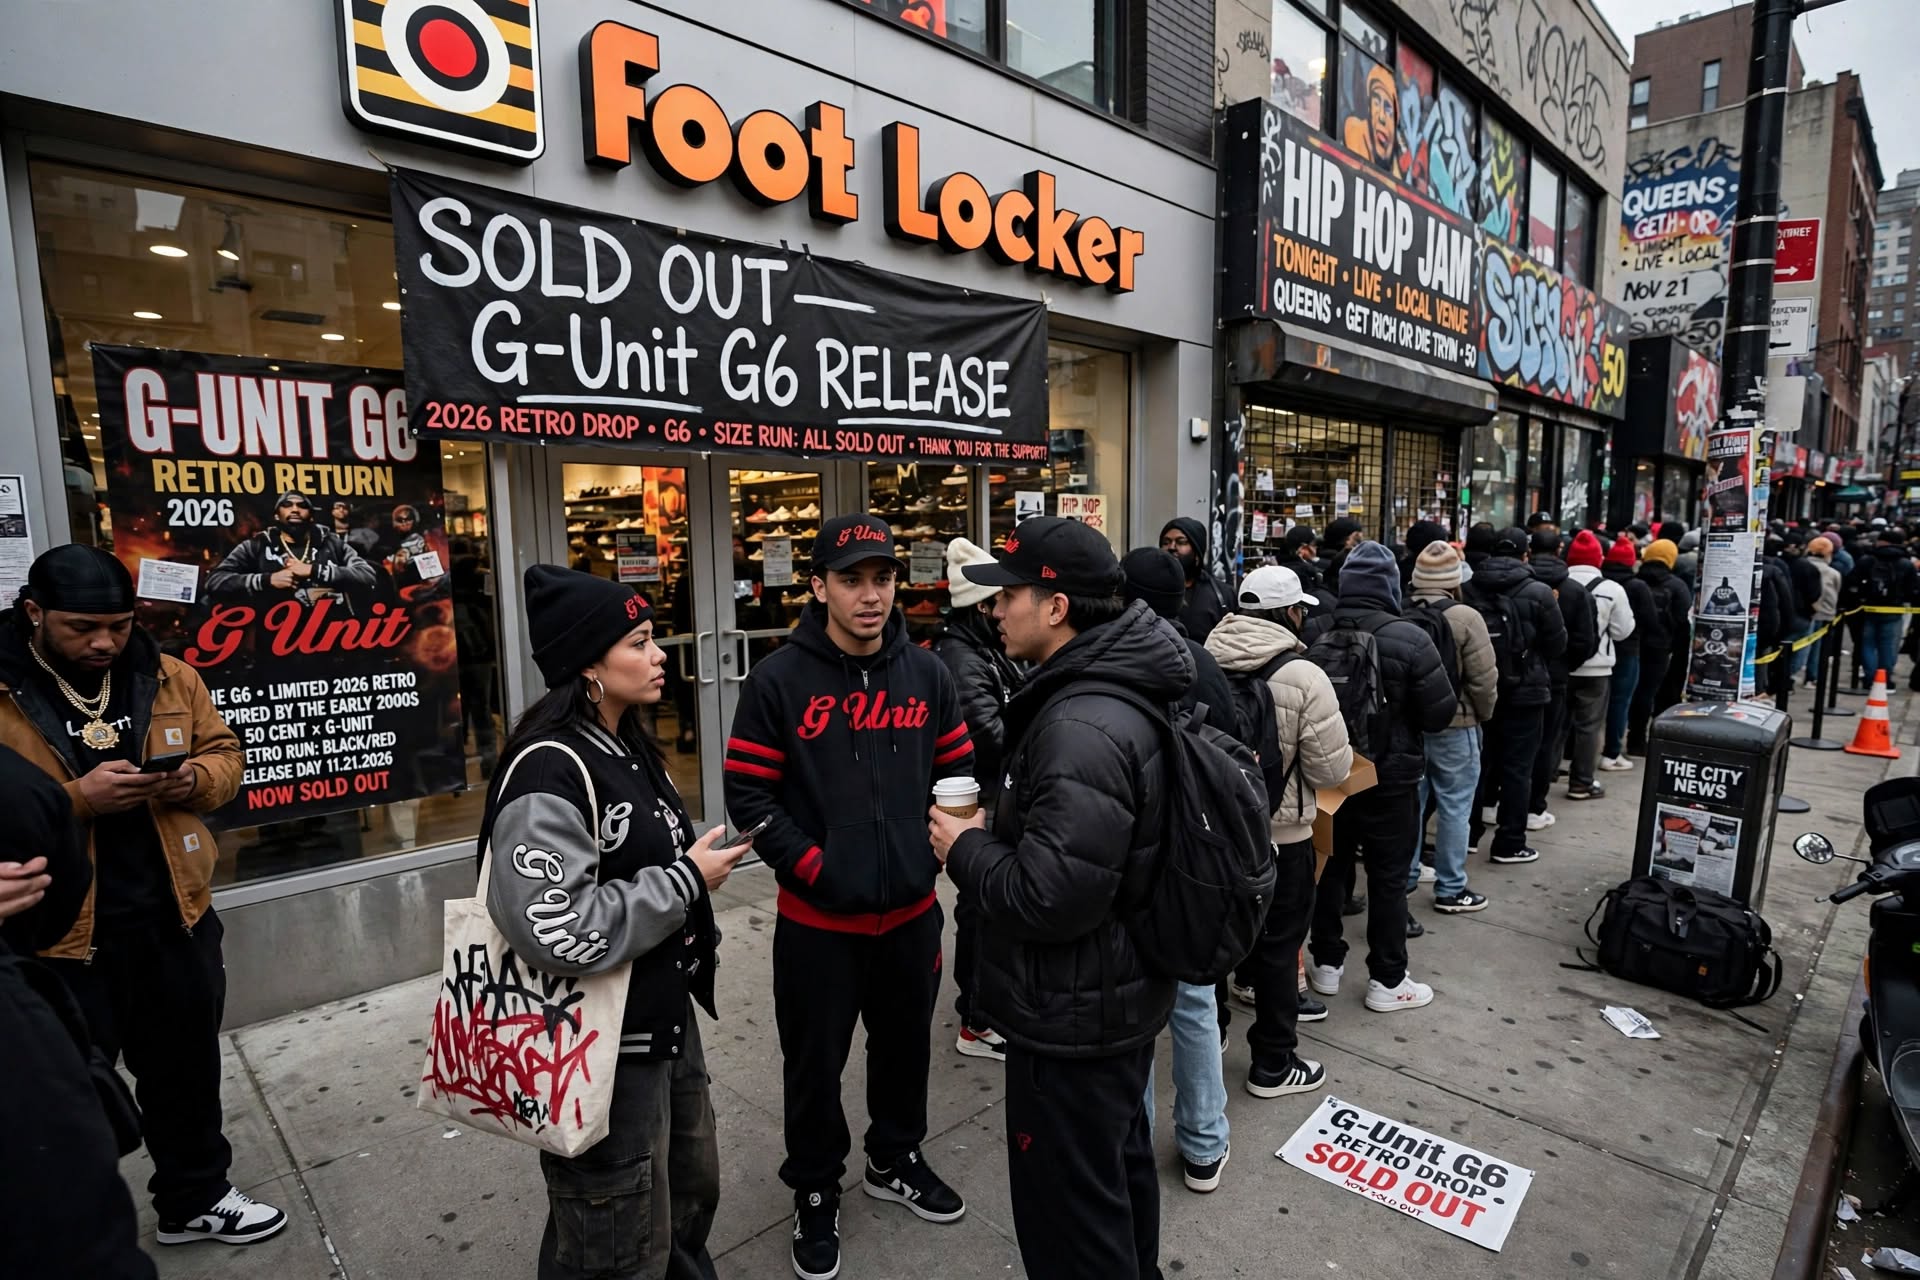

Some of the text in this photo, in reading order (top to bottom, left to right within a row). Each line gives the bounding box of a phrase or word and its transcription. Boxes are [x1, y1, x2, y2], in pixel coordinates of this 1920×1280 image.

[579, 19, 858, 223] Foot
[882, 121, 1143, 293] Locker
[1623, 177, 1726, 220] QUEENS
[1282, 139, 1345, 247] HIP
[1353, 176, 1413, 276] HOP
[1418, 216, 1472, 305] JAM
[419, 197, 631, 305] SOLD
[1634, 245, 1720, 271] LIVE LOCAL
[1273, 234, 1469, 334] TONIGHT LIVE LOCAL VENUE
[1665, 276, 1688, 298] 21
[1273, 277, 1477, 368] QUEENS GET RICH OR DIE TRYIN 50
[471, 300, 1011, 418] G-Unit G6 RELEASE
[1602, 343, 1625, 398] 50
[124, 367, 417, 461] G-UNIT G6
[426, 402, 1047, 461] 2026 RETRO DROP G6 SIZE RUN: ALL SOLD OUT THANK YOU FOR THE SUPPORT!
[152, 460, 394, 497] RETRO RETURN
[168, 498, 235, 527] 2026
[1062, 497, 1101, 514] HIP HOP
[853, 525, 888, 543] Unit
[184, 598, 413, 667] G Unit
[230, 686, 251, 704] G6
[269, 679, 329, 700] LIMITED
[333, 676, 369, 695] 2026
[372, 672, 416, 690] RETRO
[275, 704, 294, 721] BY
[298, 700, 326, 718] THE
[330, 696, 374, 715] EARLY
[376, 691, 420, 710] 2000S
[245, 727, 265, 744] 50
[269, 722, 306, 741] CENT
[325, 715, 374, 735] G-UNIT
[797, 690, 929, 740] G Unit
[241, 751, 393, 785] ELEASE DAY 11.21.2026
[245, 731, 396, 764] ETRO RUN: BLACK/RED
[247, 771, 390, 810] NOW SOLD OUT
[1664, 759, 1743, 786] THE CITY
[1673, 776, 1728, 800] NEWS
[525, 887, 610, 965] Unit
[1330, 1109, 1509, 1188] G-Unit G6
[1333, 1133, 1488, 1198] RETRO DROP
[1305, 1143, 1487, 1228] SOLD OUT
[1343, 1179, 1369, 1193] NOW
[1400, 1203, 1424, 1217] OUT
